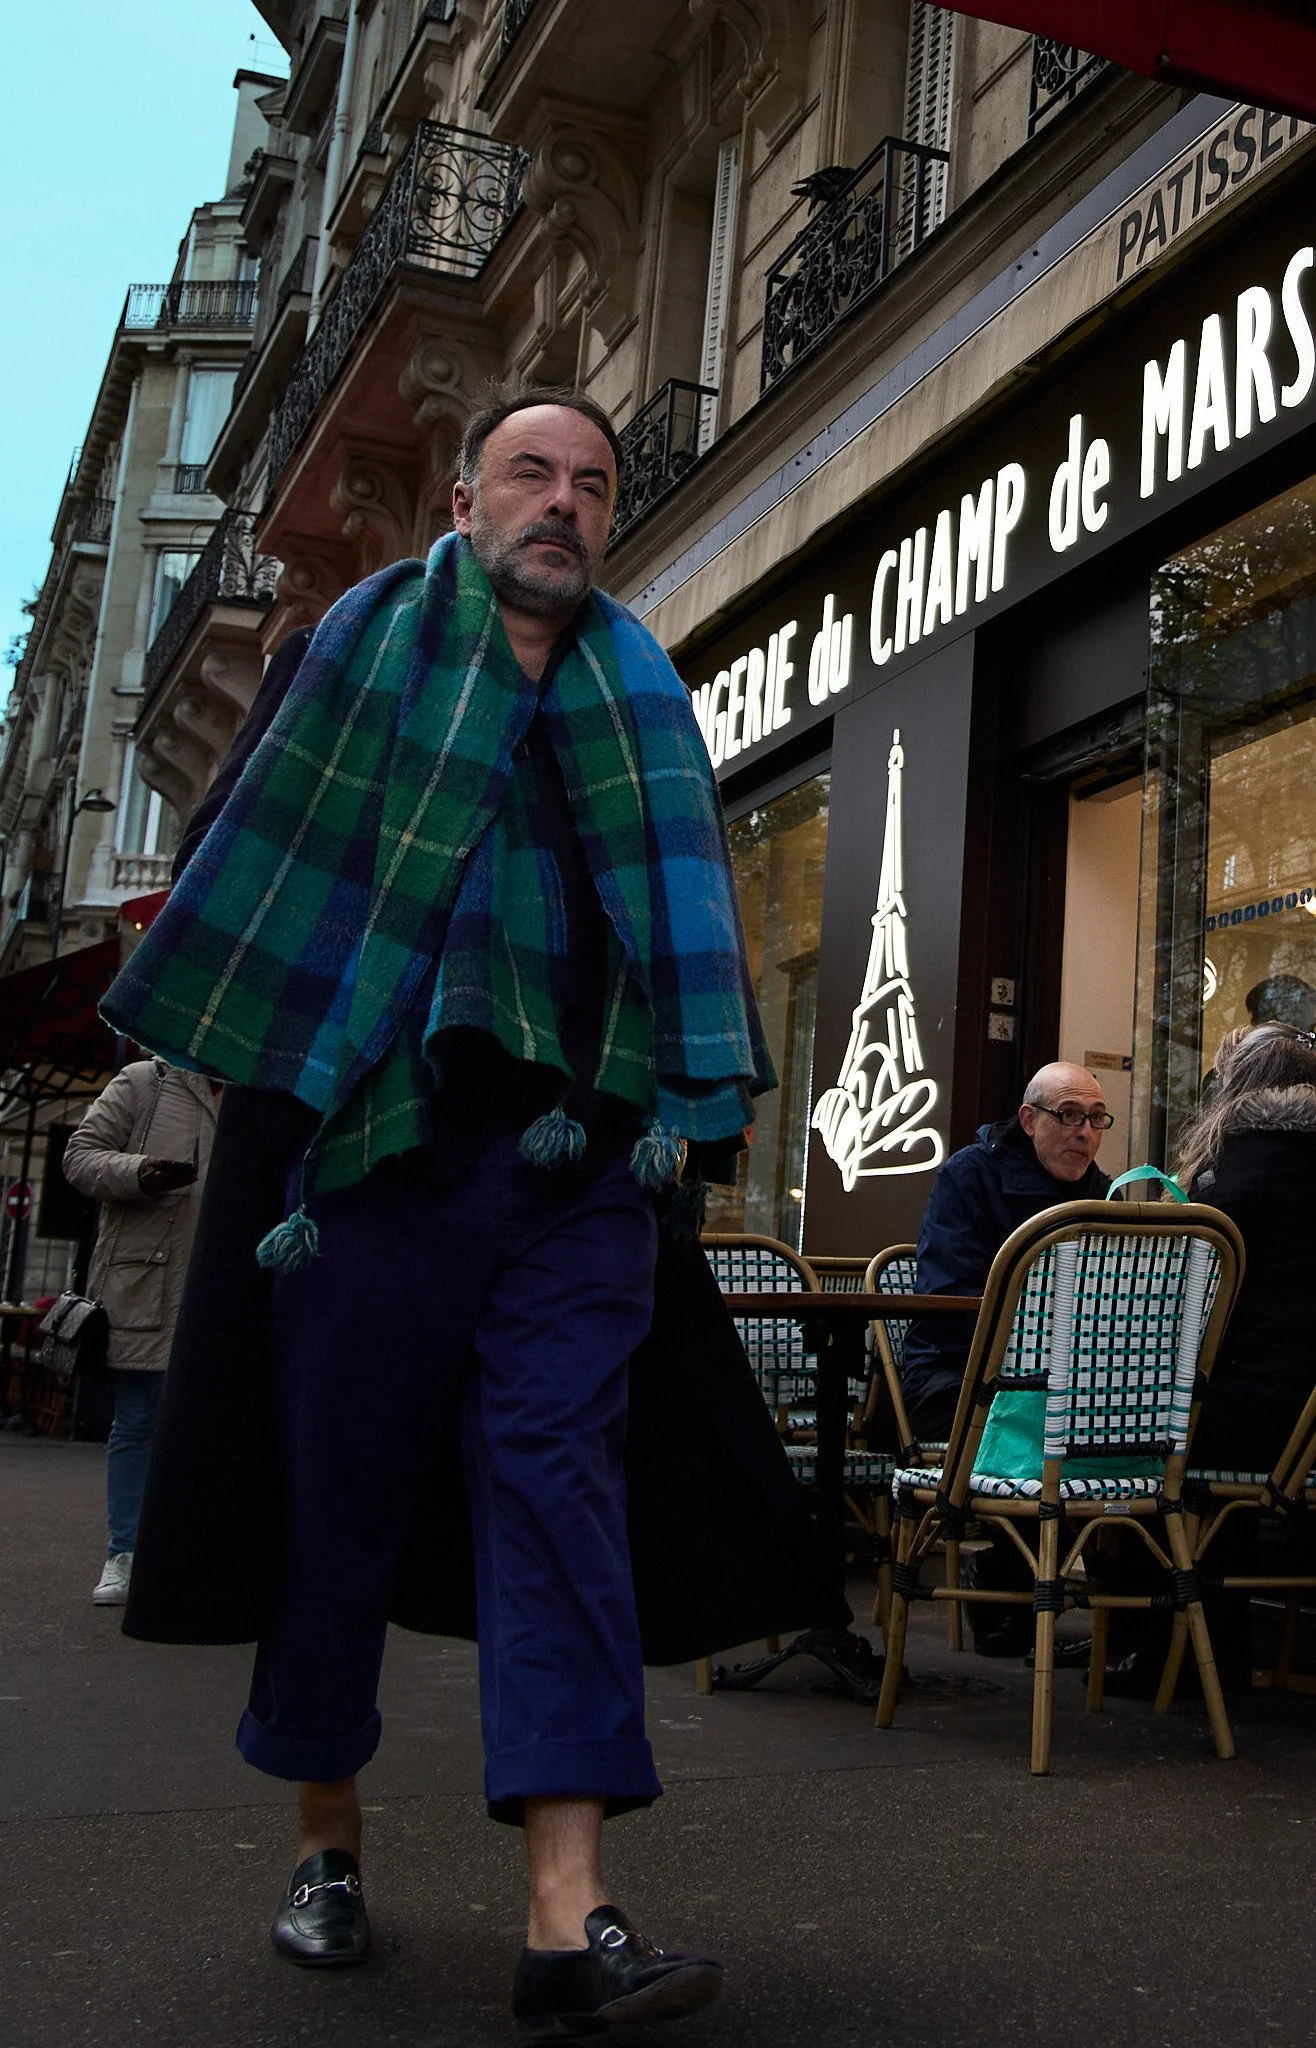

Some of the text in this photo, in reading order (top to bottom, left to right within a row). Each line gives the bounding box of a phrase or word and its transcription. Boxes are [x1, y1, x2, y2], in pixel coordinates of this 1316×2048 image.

[807, 593, 853, 706] du
[869, 462, 1026, 667] CHAMP
[1048, 413, 1110, 553] de
[1139, 246, 1316, 499] MARS
